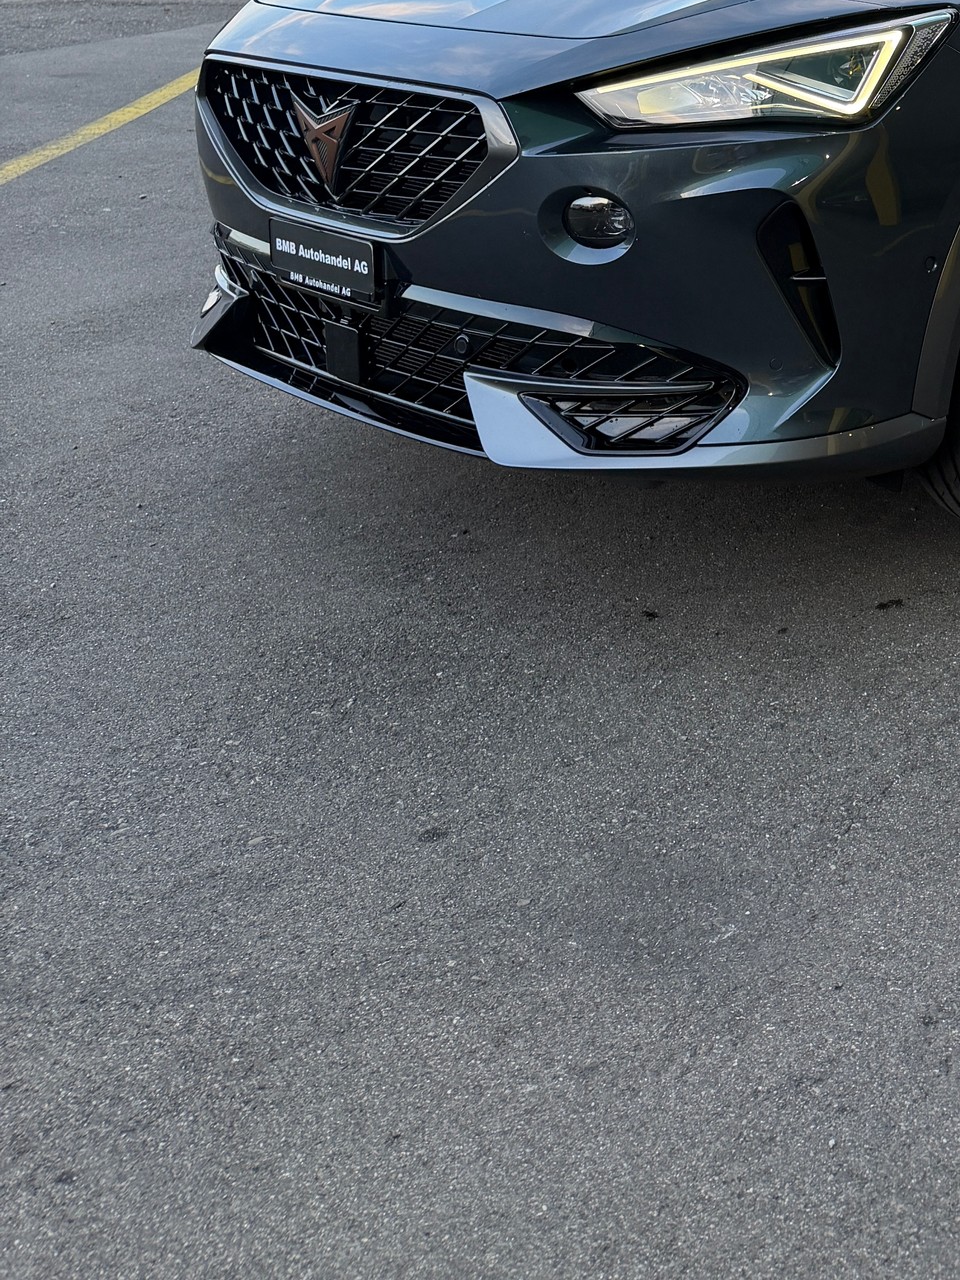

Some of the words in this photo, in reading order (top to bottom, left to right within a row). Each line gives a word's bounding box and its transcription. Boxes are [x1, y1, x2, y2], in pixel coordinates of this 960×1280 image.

[276, 238, 296, 254] BMB
[298, 244, 351, 270] Autohandel
[354, 259, 368, 274] AG
[290, 271, 303, 283] BMB
[304, 276, 340, 294] Autohandel
[341, 287, 351, 296] AG
